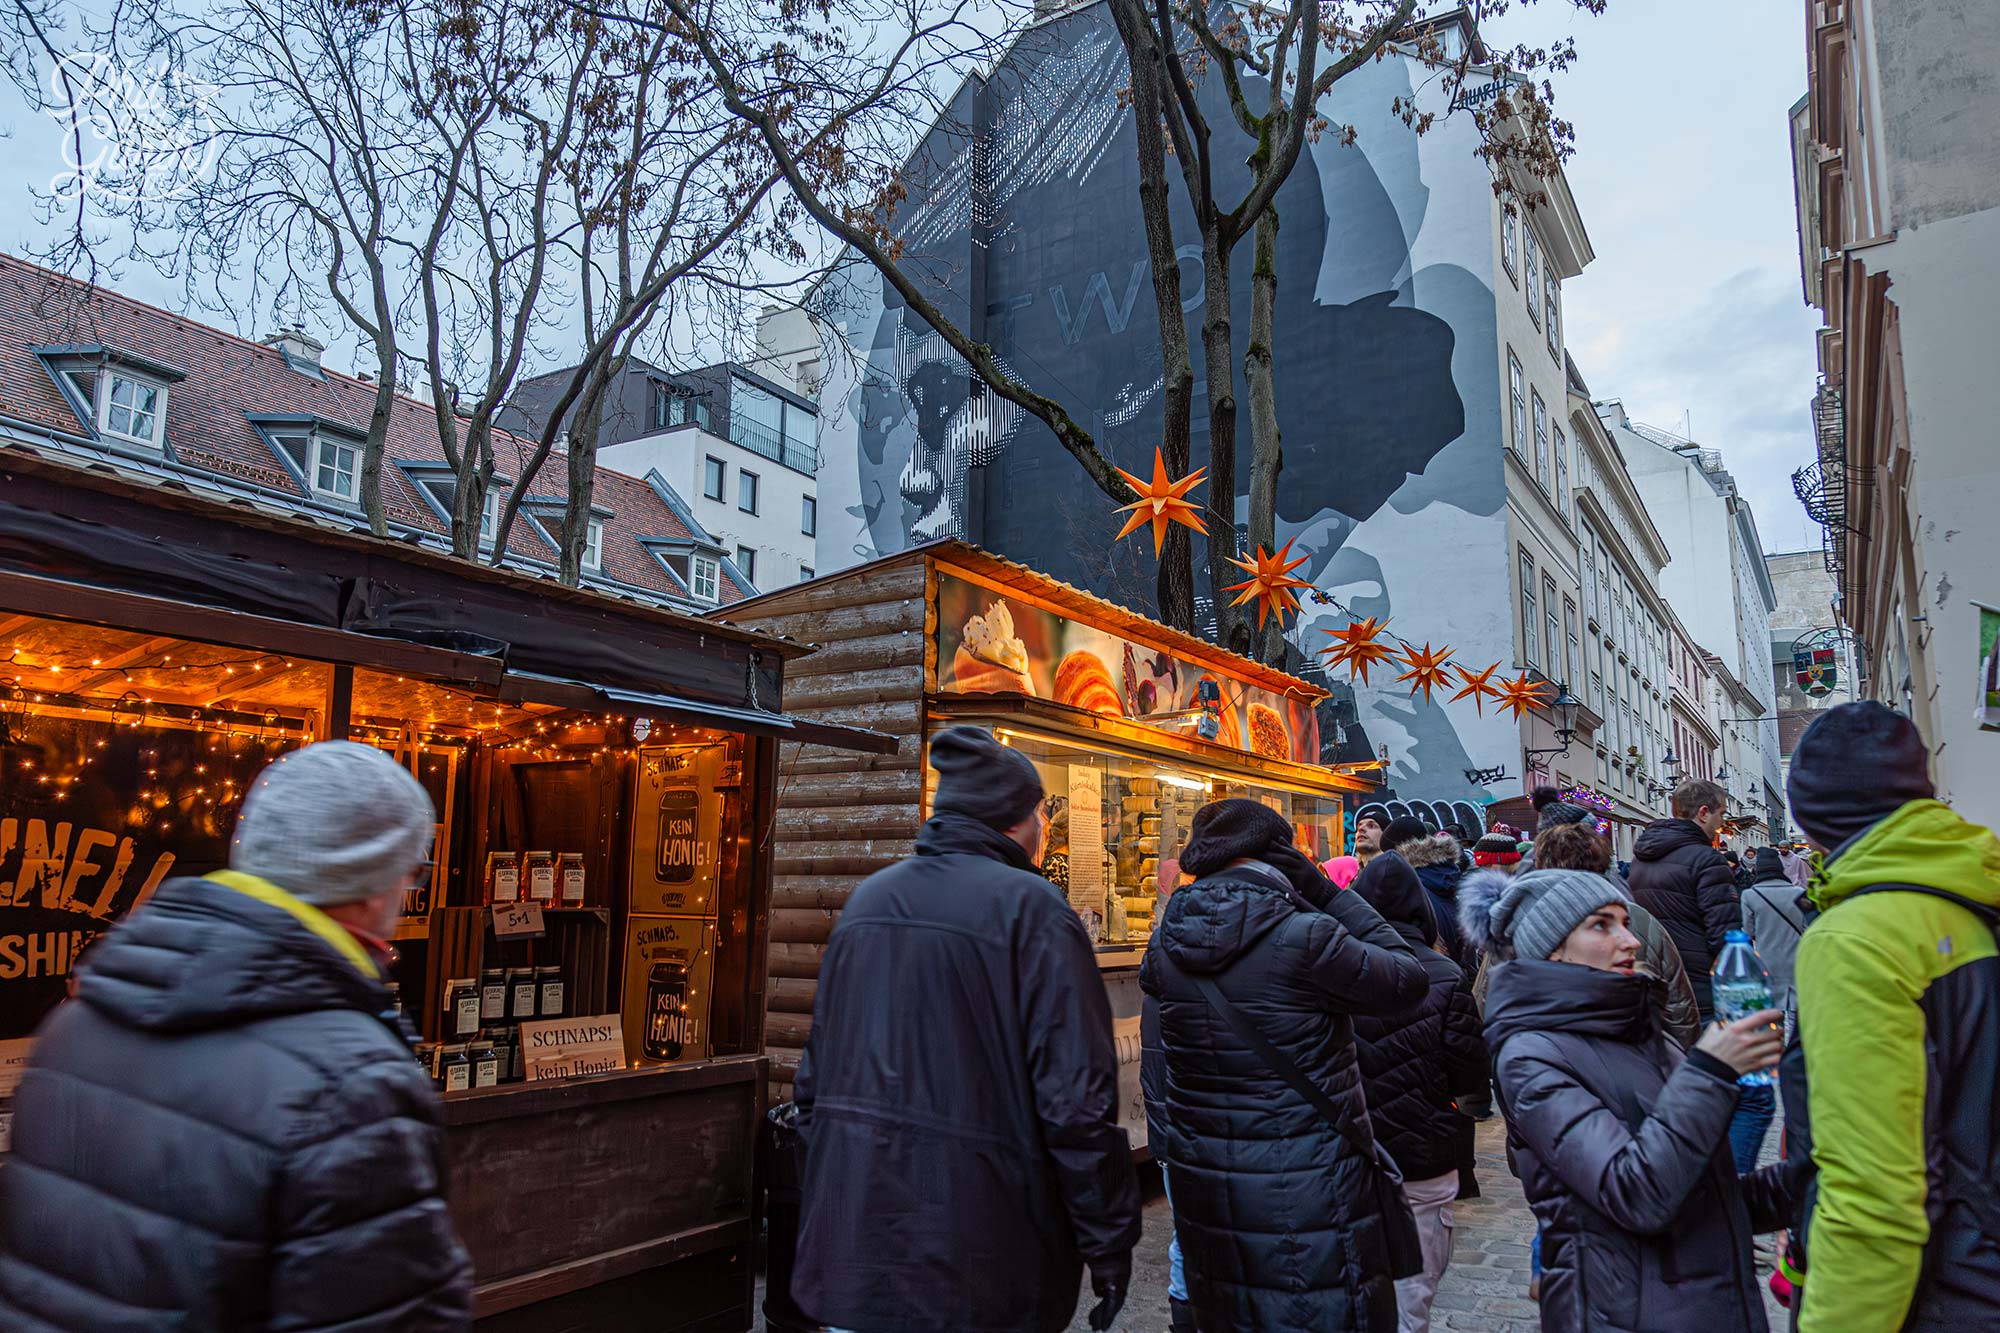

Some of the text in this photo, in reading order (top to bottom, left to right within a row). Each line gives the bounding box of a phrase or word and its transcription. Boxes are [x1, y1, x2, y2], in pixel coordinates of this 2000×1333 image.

[669, 818, 692, 836] KEIN
[662, 839, 711, 867] HONIG!
[658, 994, 680, 1011] KEIN
[533, 1026, 612, 1048] SCHNAPS!
[651, 1013, 699, 1045] HONIG!
[535, 1062, 569, 1081] kein
